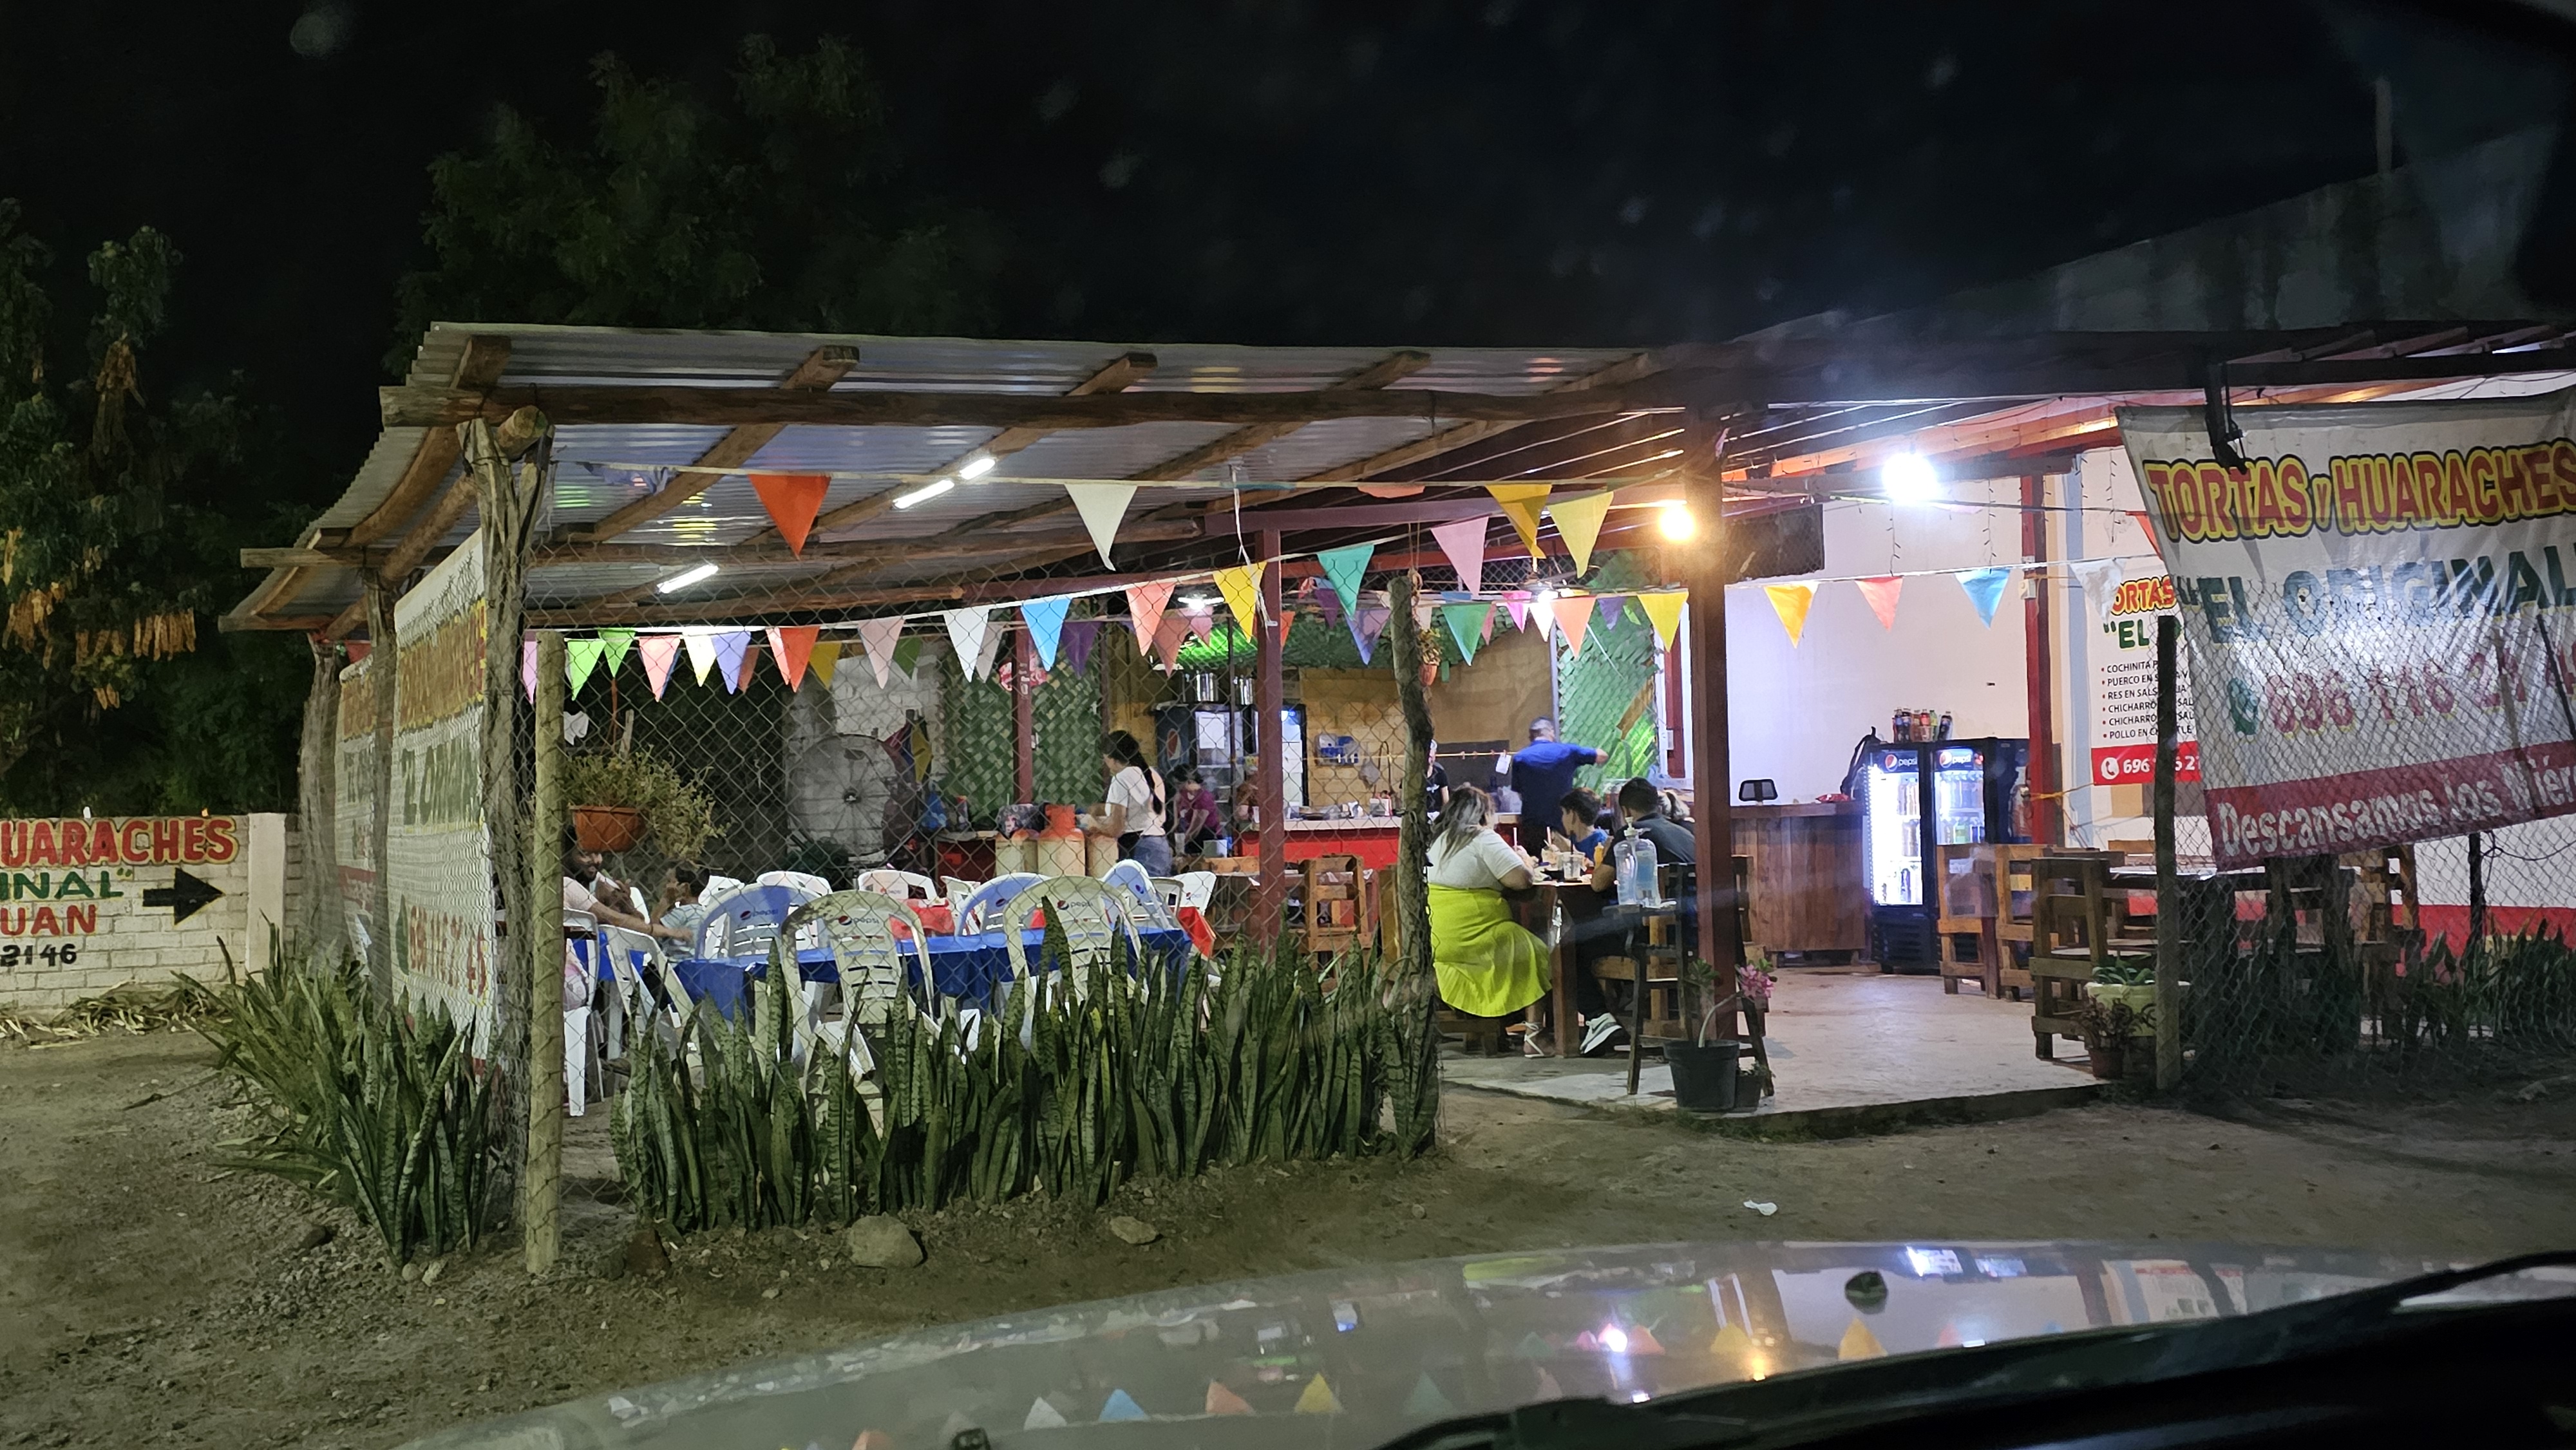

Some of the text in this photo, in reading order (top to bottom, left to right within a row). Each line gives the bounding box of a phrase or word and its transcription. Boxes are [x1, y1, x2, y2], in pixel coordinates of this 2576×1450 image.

[2145, 456, 2310, 540] TORTAS
[2332, 441, 2576, 534] HUARACHES
[2112, 576, 2175, 615] ORTAS
[2284, 541, 2576, 637] ORIGINAL
[2107, 661, 2150, 673] COCHINITA
[2107, 676, 2140, 686] PUERCO
[2142, 673, 2153, 683] EN
[2108, 690, 2123, 700] RES
[2125, 689, 2135, 699] EN
[2137, 687, 2157, 698] SALS
[2177, 697, 2194, 707] SAL
[2109, 711, 2194, 726] CHICHARRO SAL
[2110, 729, 2136, 739] POLLO
[2138, 728, 2148, 737] EN
[1899, 757, 1918, 767] pepsi
[1953, 754, 1971, 764] pepsi
[2123, 758, 2150, 774] 696
[2217, 789, 2442, 857] Descansamos
[2441, 773, 2503, 822] los
[0, 818, 237, 867] UARACHES
[0, 904, 97, 936] UAN
[752, 909, 779, 917] pepsi
[0, 943, 77, 966] 2146
